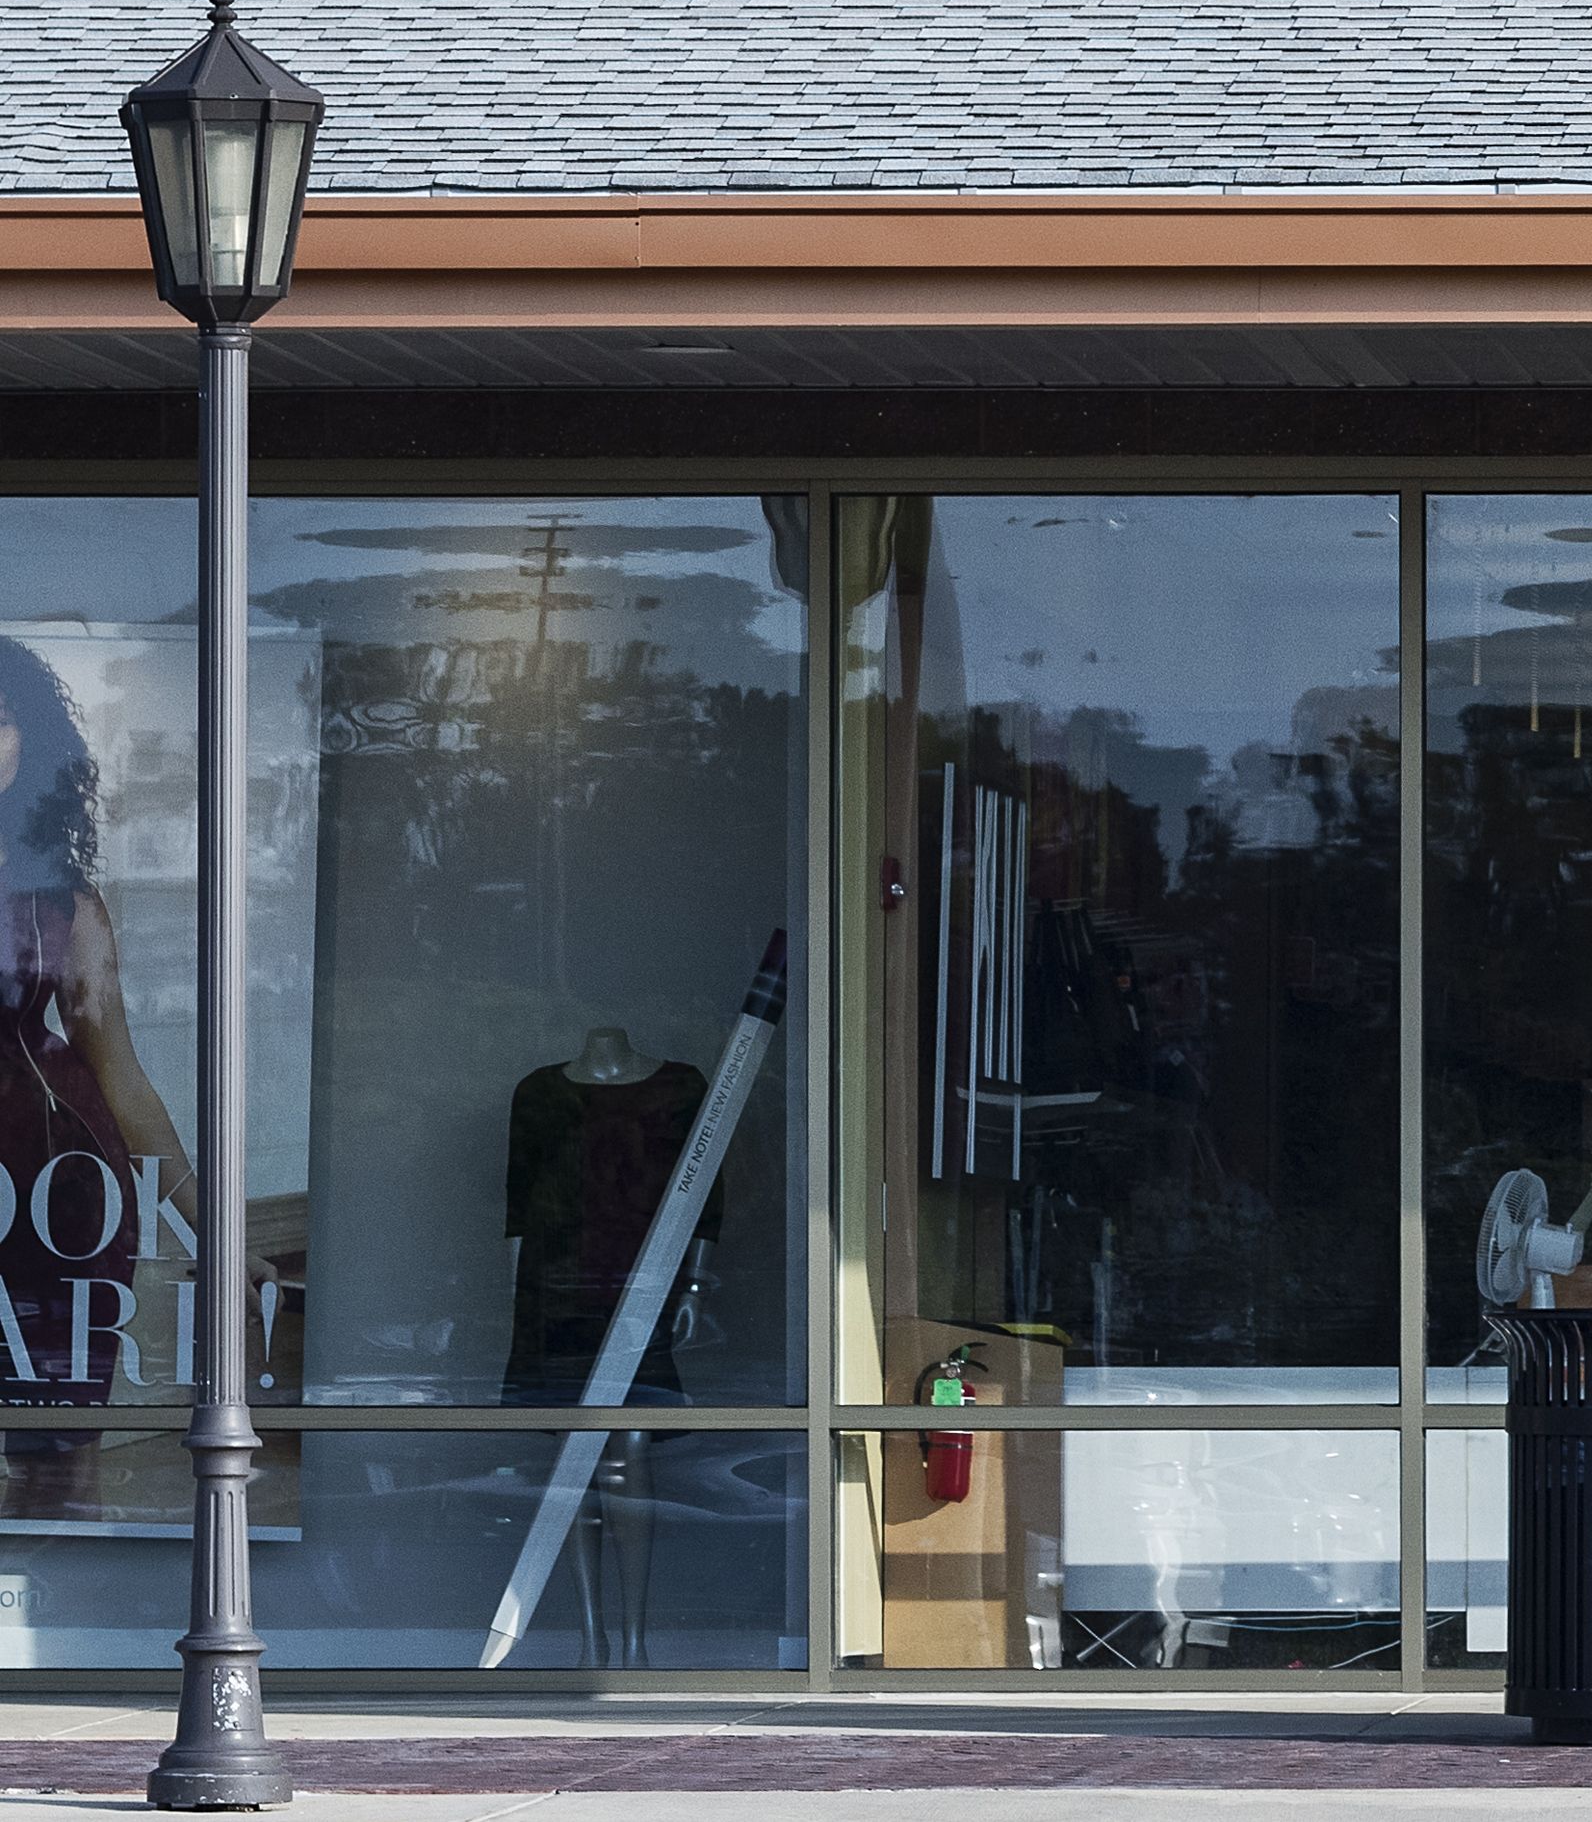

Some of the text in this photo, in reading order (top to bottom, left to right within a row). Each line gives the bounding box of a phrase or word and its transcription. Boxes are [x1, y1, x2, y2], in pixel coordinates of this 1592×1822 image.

[677, 1034, 752, 1195] TAKE NOTE! NEW FASHION
